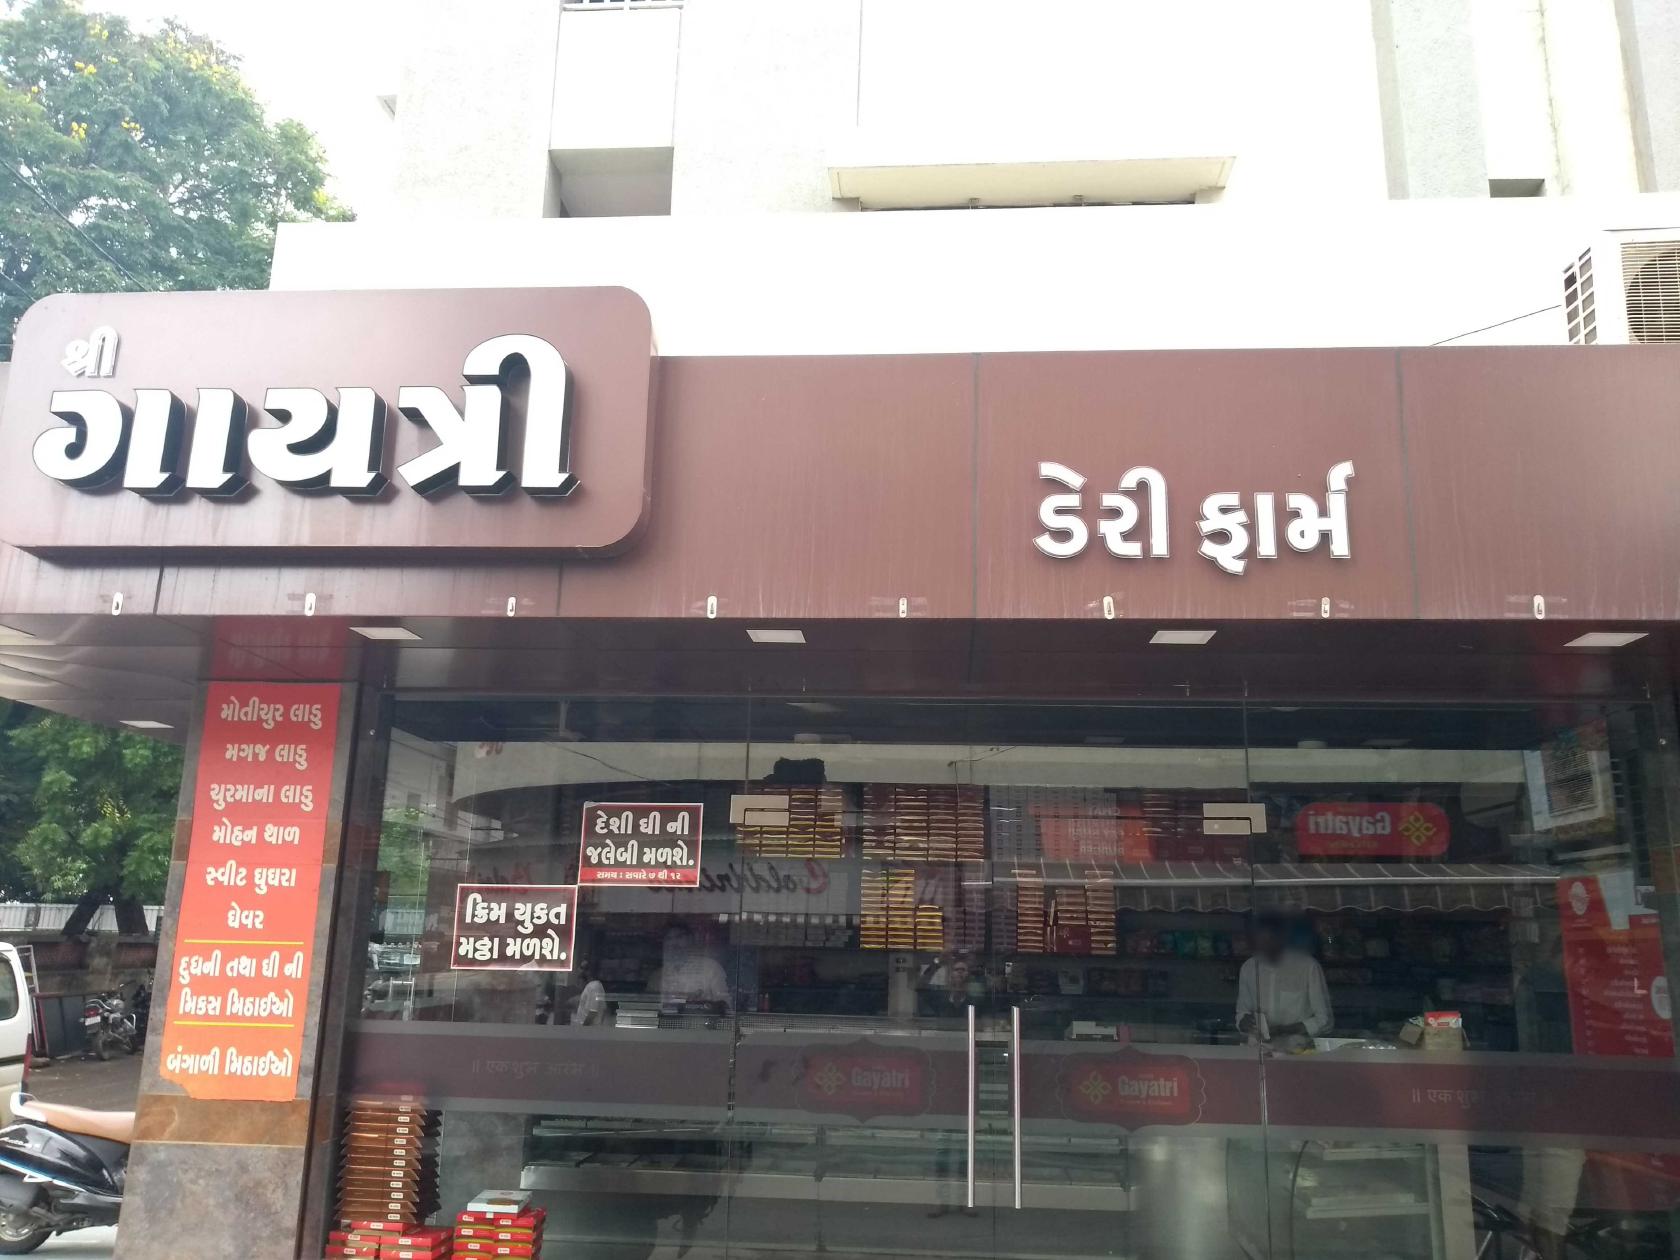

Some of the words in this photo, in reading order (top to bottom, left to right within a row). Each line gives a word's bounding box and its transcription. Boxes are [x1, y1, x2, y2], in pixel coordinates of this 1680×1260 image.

[60, 325, 119, 378] શ્રી
[32, 334, 579, 494] ગાયત્રી
[1032, 461, 1170, 559] ડેરી
[1196, 459, 1356, 576] ફાર્મ
[220, 696, 284, 730] મોતીચુર
[289, 703, 322, 729] લાડુ
[225, 743, 270, 762] મગજ
[275, 743, 308, 770] લાડુ
[210, 783, 274, 810] ચુરમાના
[280, 783, 313, 811] લાડુ
[212, 817, 257, 845] મોહન
[264, 823, 300, 845] થાળ
[595, 810, 633, 835] દેશી
[639, 811, 660, 835] ઘી
[666, 811, 690, 835] ની
[586, 839, 639, 865] જલેબી
[643, 840, 695, 866] મળશે.
[205, 858, 247, 886] સ્વીટ
[254, 866, 296, 894] ઘુઘરા
[625, 869, 647, 879] સવારે
[227, 901, 265, 929] ઘેવર
[505, 928, 567, 961] મળશે.
[178, 949, 222, 985] દુધની
[225, 956, 256, 978] તથા
[262, 950, 280, 978] ઘી
[284, 951, 304, 979] ની
[225, 988, 294, 1018] મિઠાઈઓ
[166, 1045, 220, 1075] બંગાળી
[224, 1048, 293, 1078] મિઠાઈઓ
[851, 1066, 910, 1089] Gayatri
[1118, 1075, 1179, 1099] Gayatri
